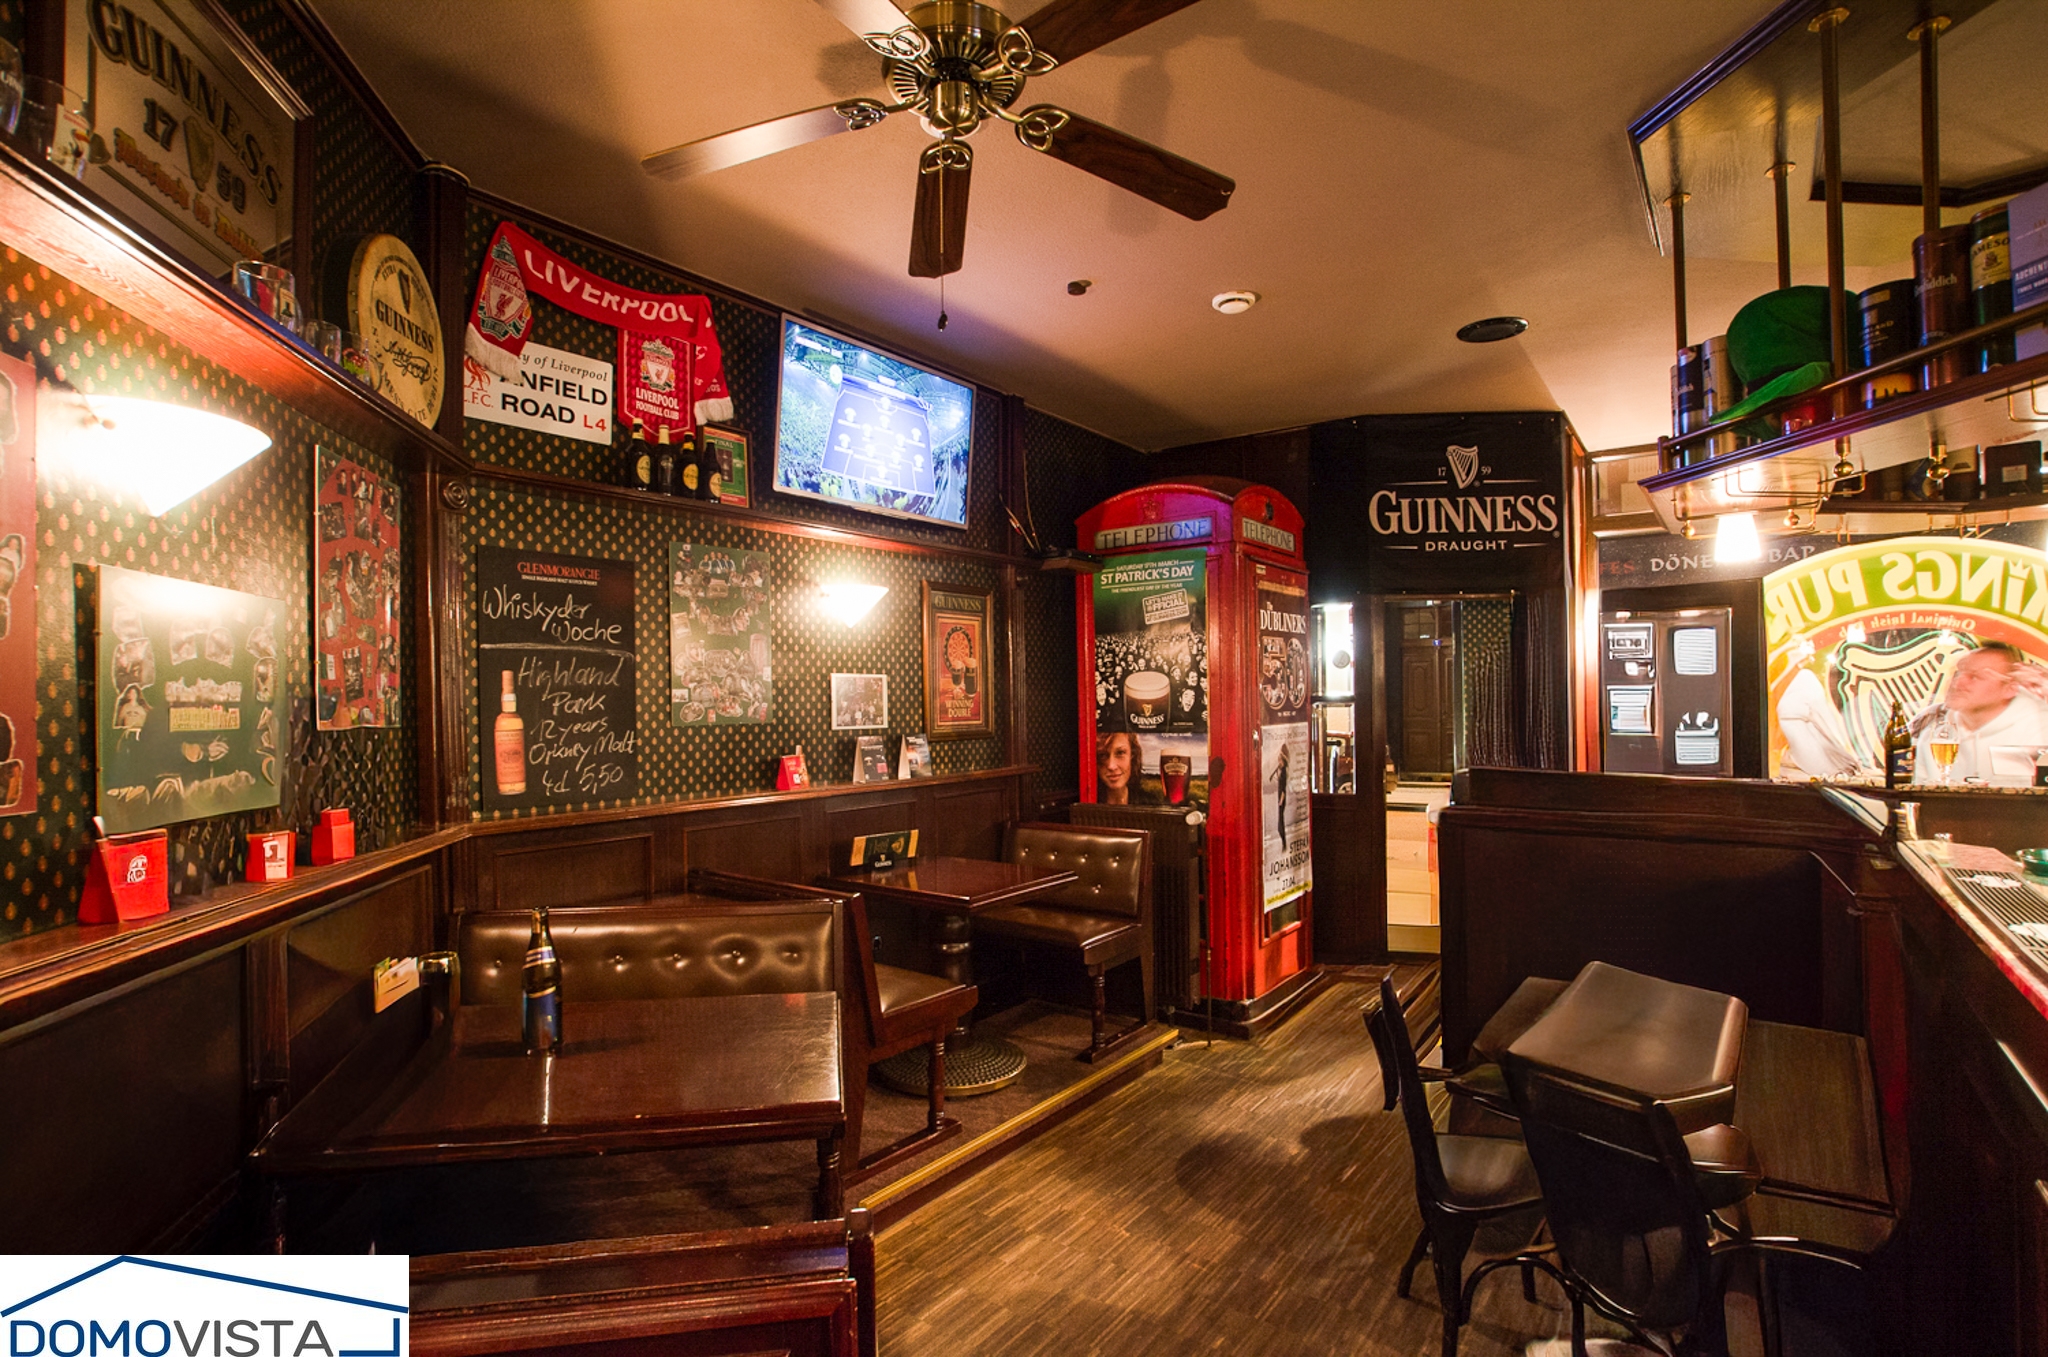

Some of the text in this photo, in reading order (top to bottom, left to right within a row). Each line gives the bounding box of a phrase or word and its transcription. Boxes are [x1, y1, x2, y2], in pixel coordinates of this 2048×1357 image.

[87, 0, 282, 206] GUINNESS
[143, 98, 246, 214] 17 59
[525, 249, 694, 323] LIVERPOOL
[375, 299, 434, 354] GUINNESS
[533, 356, 548, 369] of
[550, 358, 608, 383] Liverpool
[499, 369, 608, 405] NFIELD
[635, 387, 680, 411] LIVERPOOL
[501, 392, 607, 433] ROAD L4
[635, 400, 680, 421] FOOTBALL CLUB
[1438, 467, 1447, 476] 17
[1368, 490, 1559, 535] GUINNESS
[1101, 518, 1207, 550] TELEPHONE
[1244, 520, 1294, 550] TELEPHONE
[1425, 540, 1508, 551] DRAUGHT
[517, 561, 600, 581] GLENMORANGIE
[1101, 565, 1194, 585] ST PATRICK'S DAY
[1650, 553, 1716, 573] DÖNE
[934, 595, 981, 610] GUINNESS
[551, 618, 622, 645] Woche
[1260, 610, 1306, 635] DUBLINERS
[517, 655, 624, 701] Highland
[547, 691, 607, 716] Park
[948, 708, 972, 717] DOUBLE
[530, 716, 609, 746] 12 years
[1130, 713, 1165, 724] GUINNESS
[529, 742, 592, 773] Orkney
[594, 730, 636, 756] Malt
[579, 763, 624, 795] 5,50
